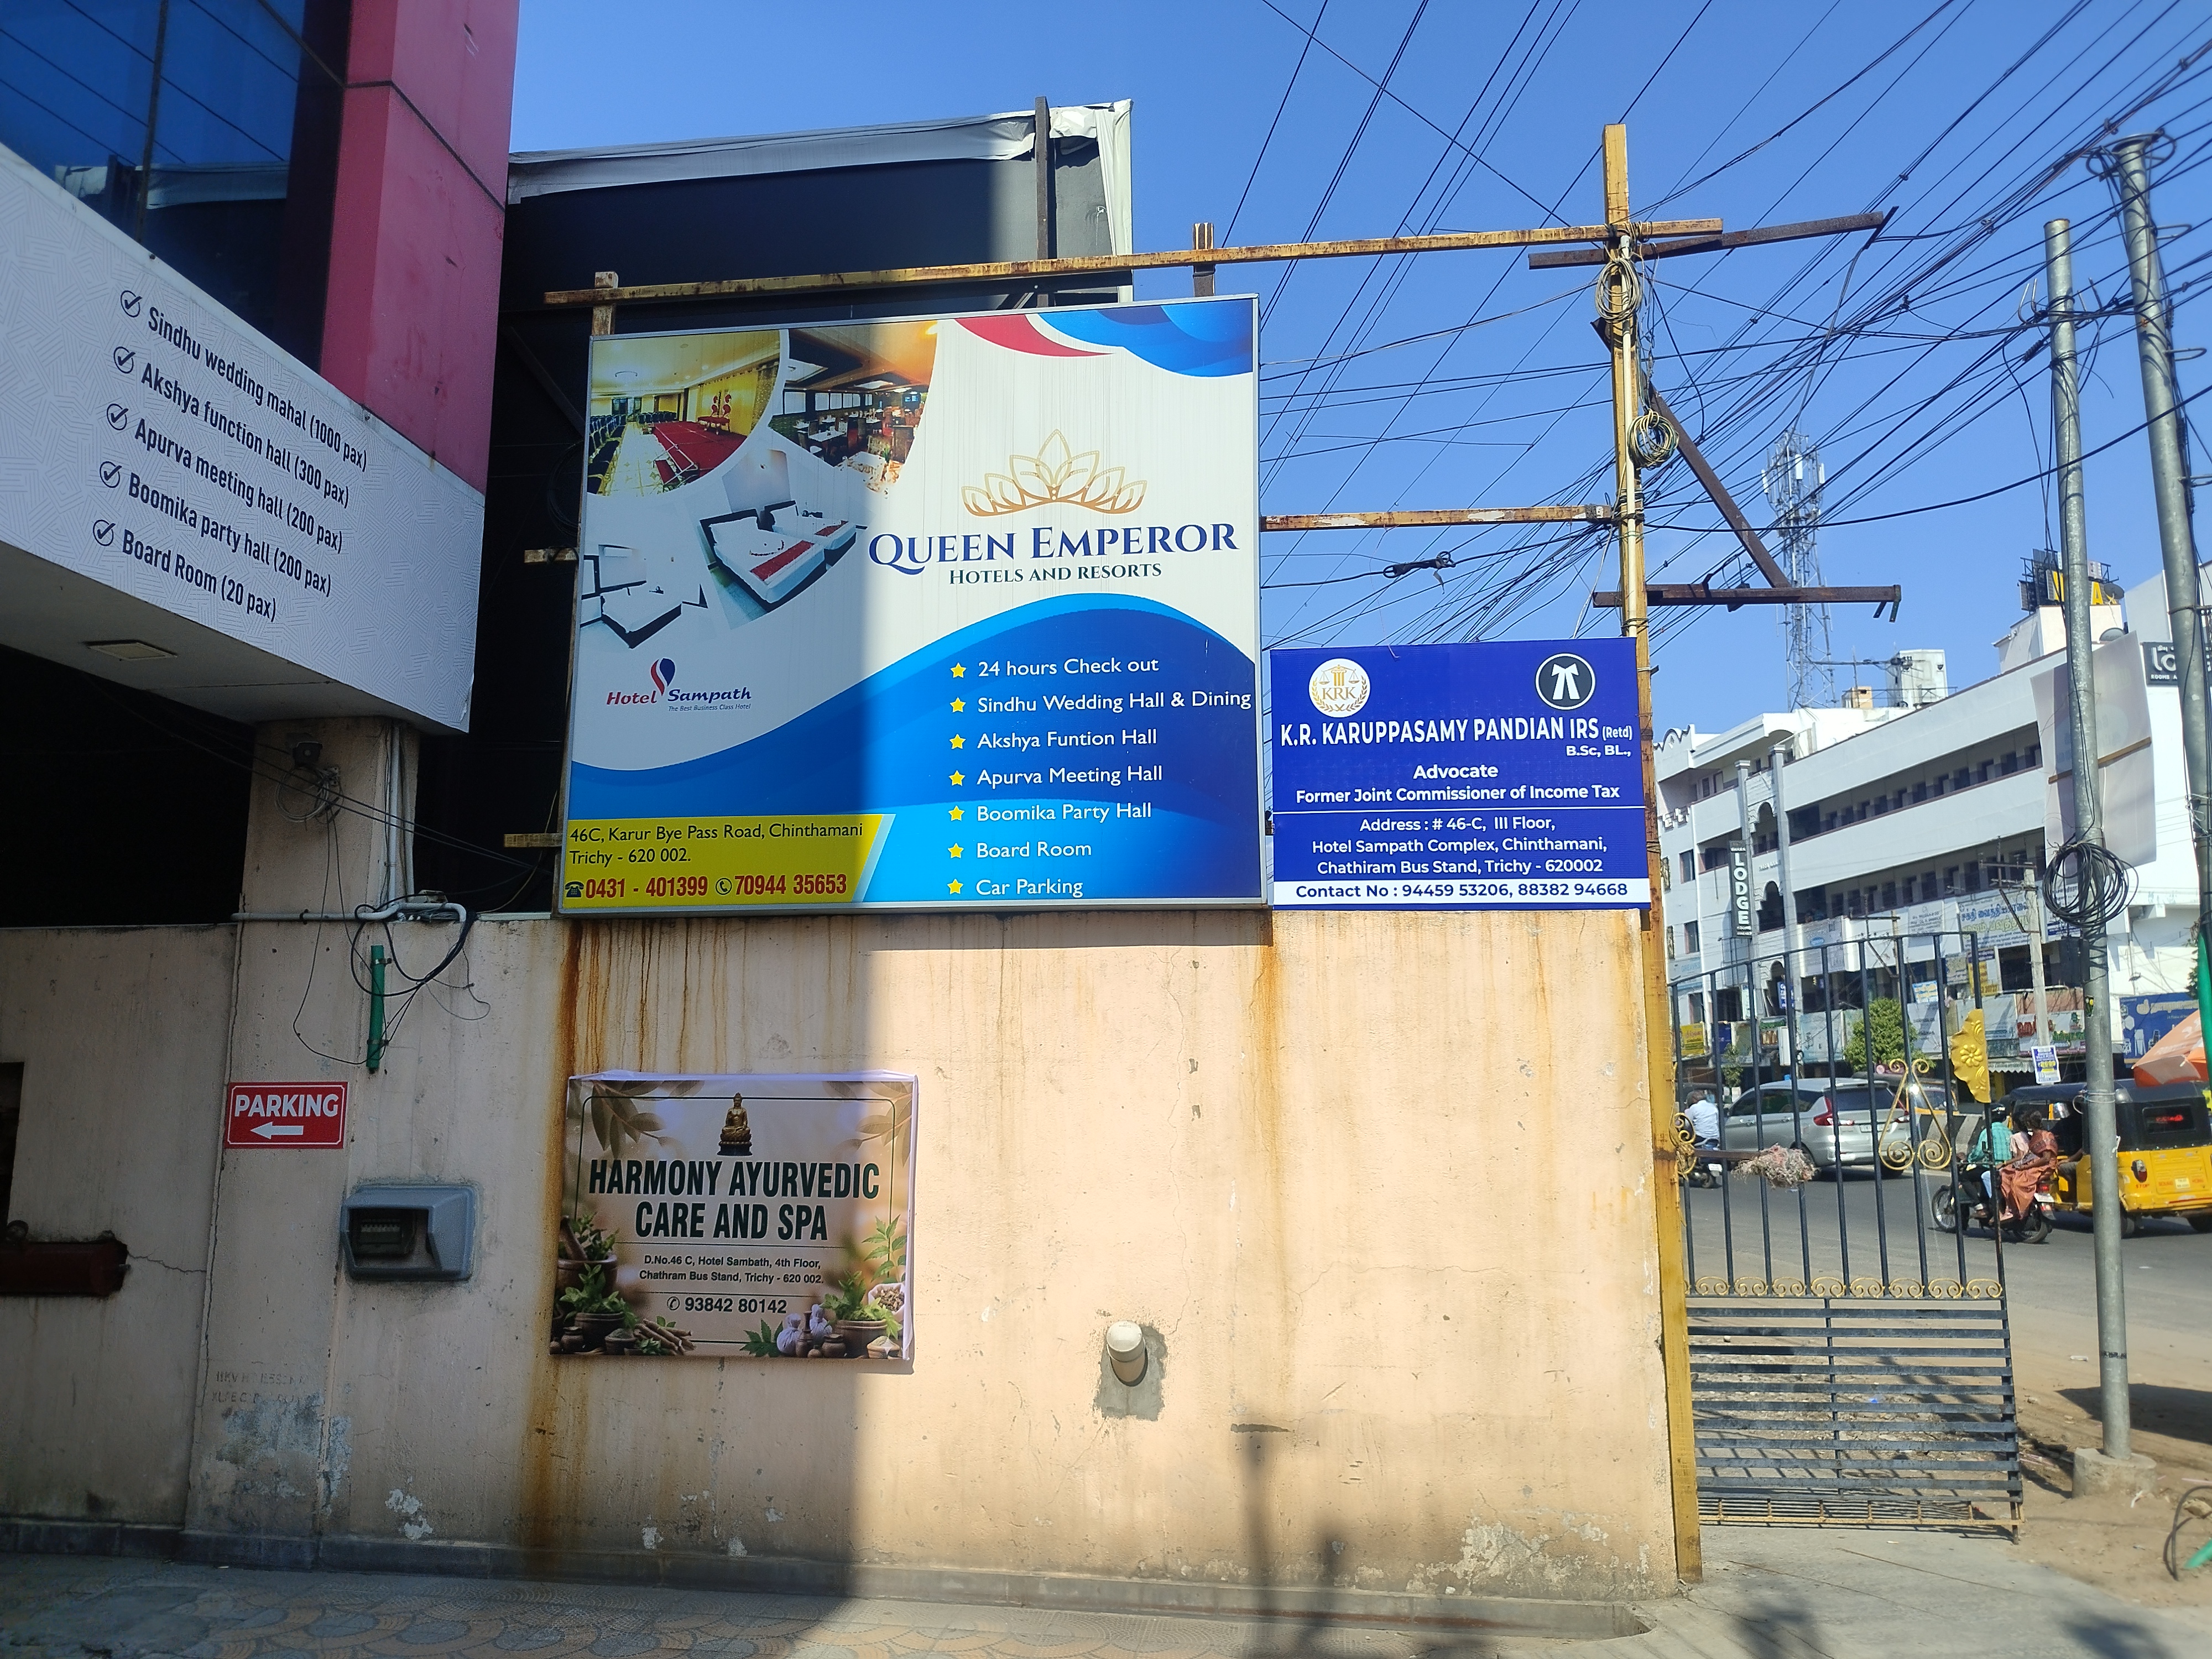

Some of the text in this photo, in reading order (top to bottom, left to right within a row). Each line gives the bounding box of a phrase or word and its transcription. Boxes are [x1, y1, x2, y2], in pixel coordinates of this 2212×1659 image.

[149, 306, 367, 472] Sindhu wedding mahal (1000 pax)
[142, 363, 349, 508] Akshya function hall (300 pax)
[134, 418, 342, 554] Apurva meeting hall (200 pax)
[129, 473, 331, 597] Boomika party hall (200 pax)
[868, 523, 1240, 575] QUEEN EMPEROR
[122, 529, 276, 623] Board Room (20 pax)
[949, 564, 1162, 585] HOTELS AND RESORTS
[978, 658, 1159, 677] 24 hours Check out
[607, 687, 752, 705] Hotel Sampath
[978, 691, 1252, 713] Sindhu Wedding Hall & Dining
[1321, 687, 1356, 700] KRK
[977, 729, 1157, 752] Akshya Funtion Hall
[1280, 717, 1633, 747] K.R. KARUPPASAMY PANDIAN IRS (Retd)
[1566, 745, 1631, 759] B.Sc, BL.,
[977, 766, 1162, 789] Apurva Meeting Hall
[1413, 764, 1498, 779] Advocate
[1296, 785, 1620, 804] Former Joint Commissioner of Income Tax
[978, 802, 1151, 823] Boomika Party Hall
[570, 823, 863, 843] 46C, Karur Bye Pass Road, Chinthamani
[1432, 818, 1443, 830] #
[1446, 817, 1486, 832] 46-C,
[1494, 817, 1508, 829] III
[1513, 816, 1555, 831] Floor,
[977, 841, 1092, 858] Board Room
[1312, 837, 1606, 856] Hotel Sampath Complex, Chinthamani,
[570, 851, 613, 868] Trichy
[628, 848, 656, 863] 620
[660, 848, 691, 862] 002.
[1317, 861, 1396, 875] Chathiram
[1401, 861, 1429, 874] Bus
[1432, 860, 1481, 875] Stand,
[1484, 859, 1532, 875] Trichy
[1545, 859, 1603, 872] 620002
[586, 878, 625, 899] 0431
[646, 877, 708, 897] 401399
[734, 875, 786, 895] 70944
[793, 874, 846, 894] 35653
[976, 878, 1083, 898] Car Parking
[1296, 885, 1361, 899] Contact
[1366, 885, 1389, 897] No
[1402, 884, 1454, 896] 94459
[1459, 884, 1513, 899] 53206,
[1518, 884, 1569, 896] 88382
[1574, 883, 1627, 895] 94668
[1734, 853, 1749, 925] LODGE
[234, 1093, 339, 1117] PARKING
[588, 1159, 880, 1199] HARMONY AYURVEDIC
[635, 1202, 828, 1240] CARE AND SPA
[644, 1255, 821, 1269] D.No.46 C, Hotel Sambath, 4th Floor,
[639, 1270, 686, 1281] Chathram
[689, 1271, 708, 1281] Bus
[710, 1272, 742, 1284] Stand,
[744, 1272, 774, 1285] Trichy
[783, 1273, 801, 1283] 620
[804, 1274, 823, 1284] 002.
[685, 1297, 787, 1314] 93842 80142
